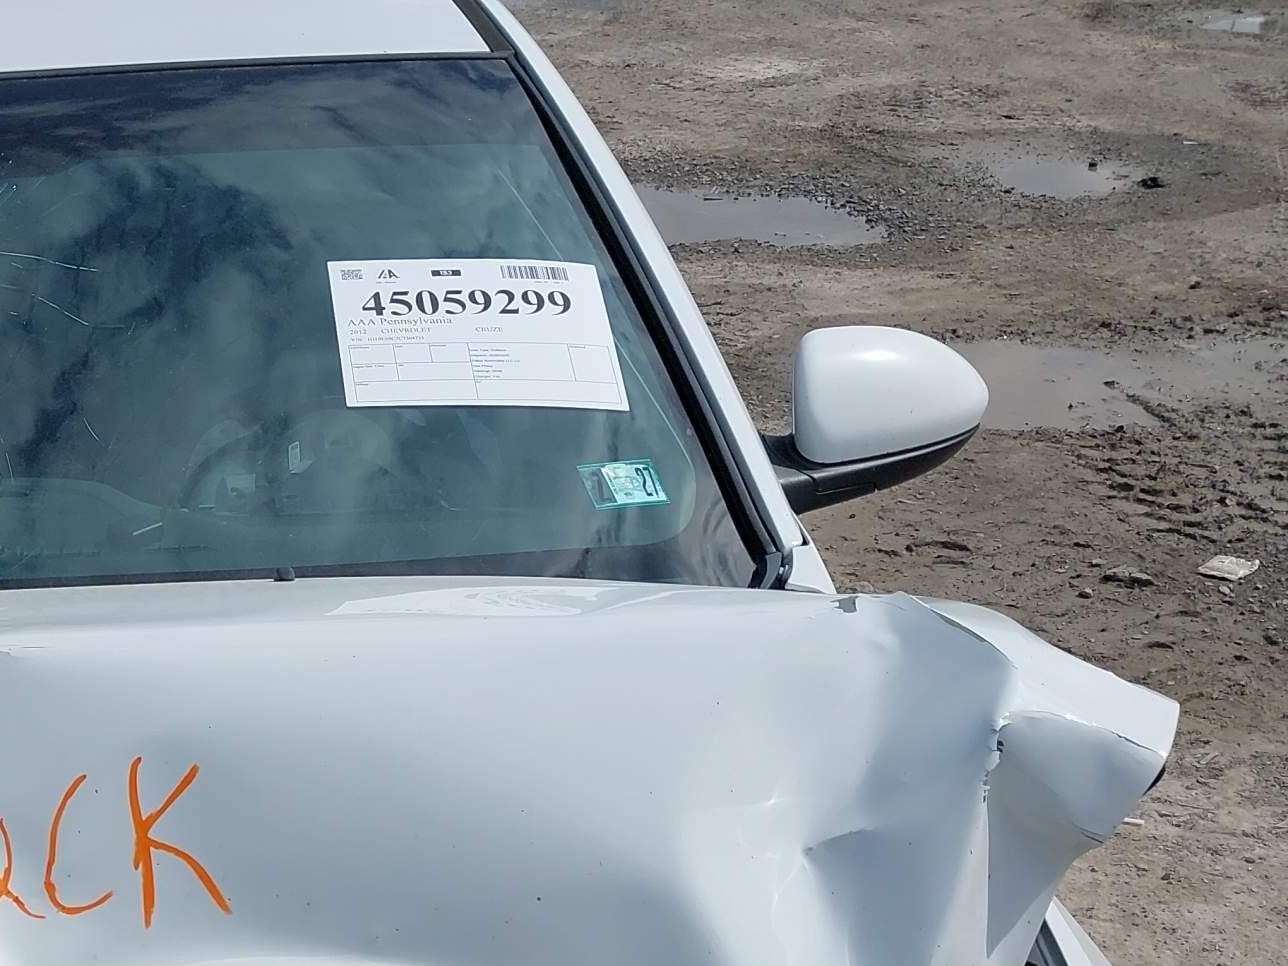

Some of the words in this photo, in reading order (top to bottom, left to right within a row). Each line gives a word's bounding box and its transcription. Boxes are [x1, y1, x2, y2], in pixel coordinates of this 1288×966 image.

[362, 289, 571, 316] 45059299
[348, 319, 376, 327] AAA
[380, 317, 453, 327] Pennsylvania
[634, 466, 659, 498] 27
